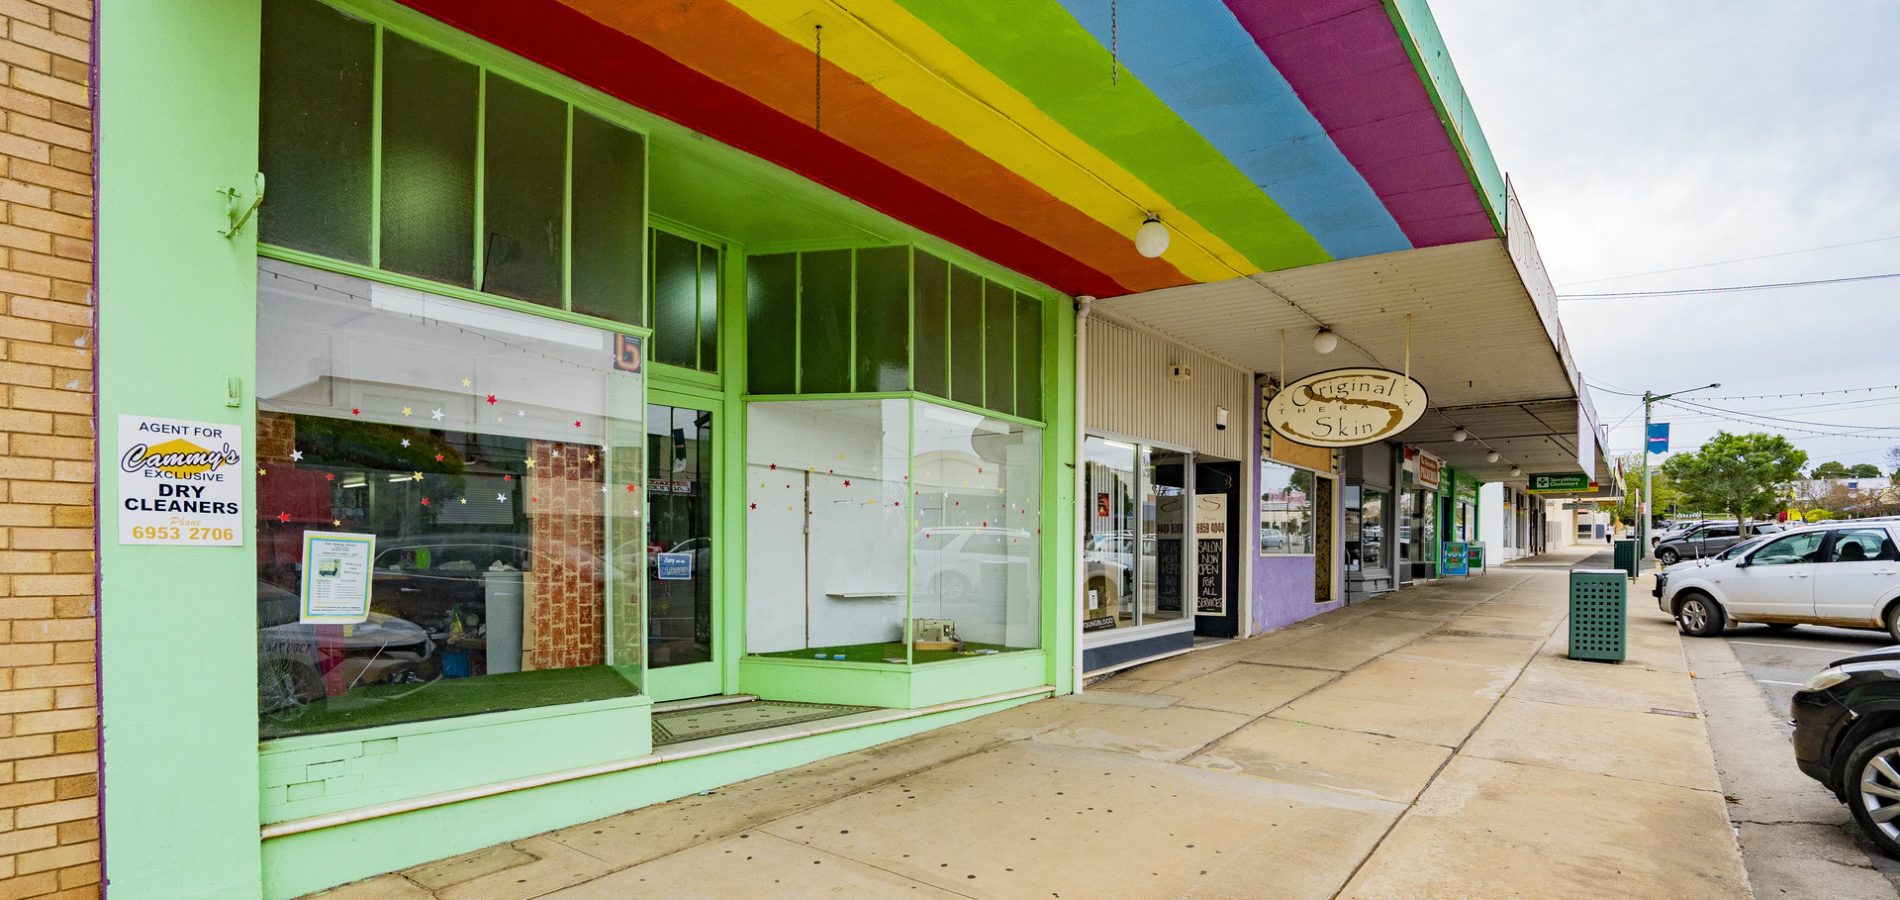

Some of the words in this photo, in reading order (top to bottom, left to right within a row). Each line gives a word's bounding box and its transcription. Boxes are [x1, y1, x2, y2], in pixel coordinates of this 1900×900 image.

[1292, 378, 1397, 406] Original
[139, 422, 190, 436] AGENT
[194, 427, 222, 438] FOR
[1311, 416, 1373, 438] Skin
[121, 442, 240, 473] Cammy's
[144, 469, 224, 482] EXCLUSIVE
[159, 483, 205, 498] DRY
[124, 498, 239, 515] CLEANERS
[170, 516, 201, 526] Phone
[132, 526, 180, 540] 6953
[189, 527, 233, 541] 2706
[1198, 540, 1222, 553] SALON
[1201, 553, 1219, 564] NOW
[1198, 563, 1219, 575] OPEN
[1202, 576, 1215, 587] FOR
[1202, 587, 1218, 596] ALL
[1198, 597, 1222, 608] SERVICES
